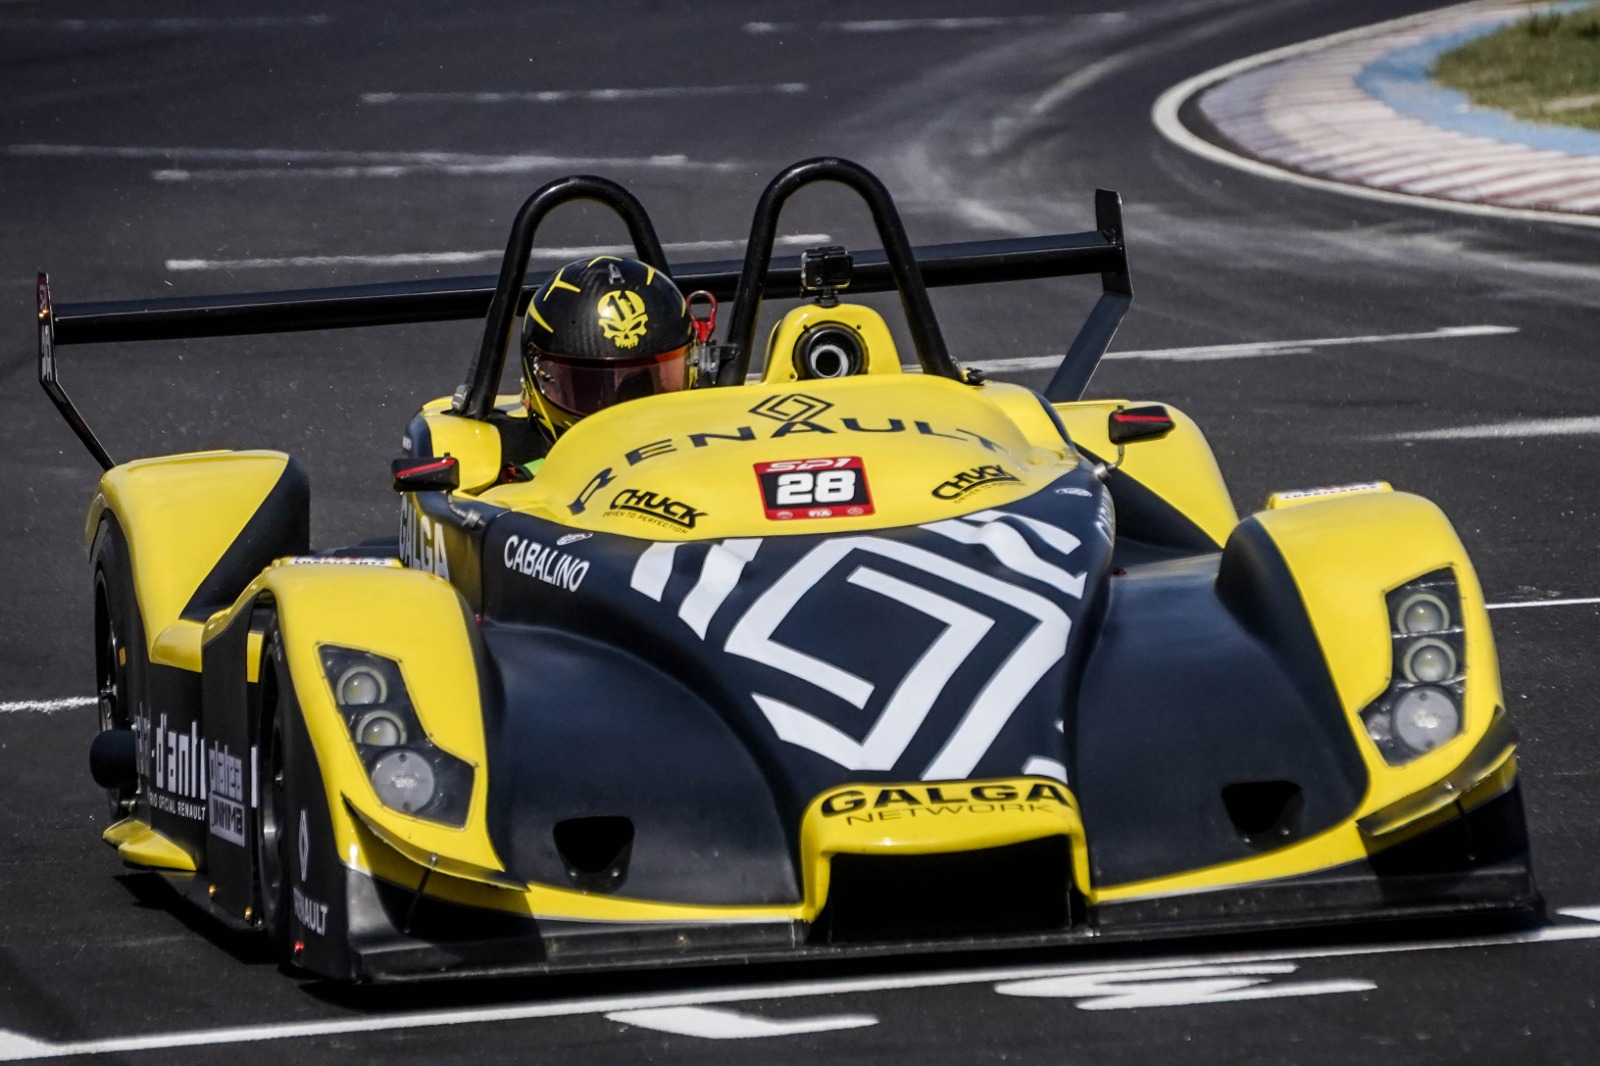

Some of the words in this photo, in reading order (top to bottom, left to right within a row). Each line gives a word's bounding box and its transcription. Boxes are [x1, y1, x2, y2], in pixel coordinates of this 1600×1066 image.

[566, 417, 1009, 516] RENAULT
[931, 464, 1021, 500] CHUCK
[776, 469, 856, 505] 28
[609, 489, 709, 530] CHUCK
[627, 511, 637, 519] TO
[638, 515, 688, 535] PERFECTION
[504, 534, 590, 592] CABALINO
[178, 801, 206, 821] RENAULT
[821, 783, 1072, 818] GALGA
[846, 804, 1053, 826] NETWORK
